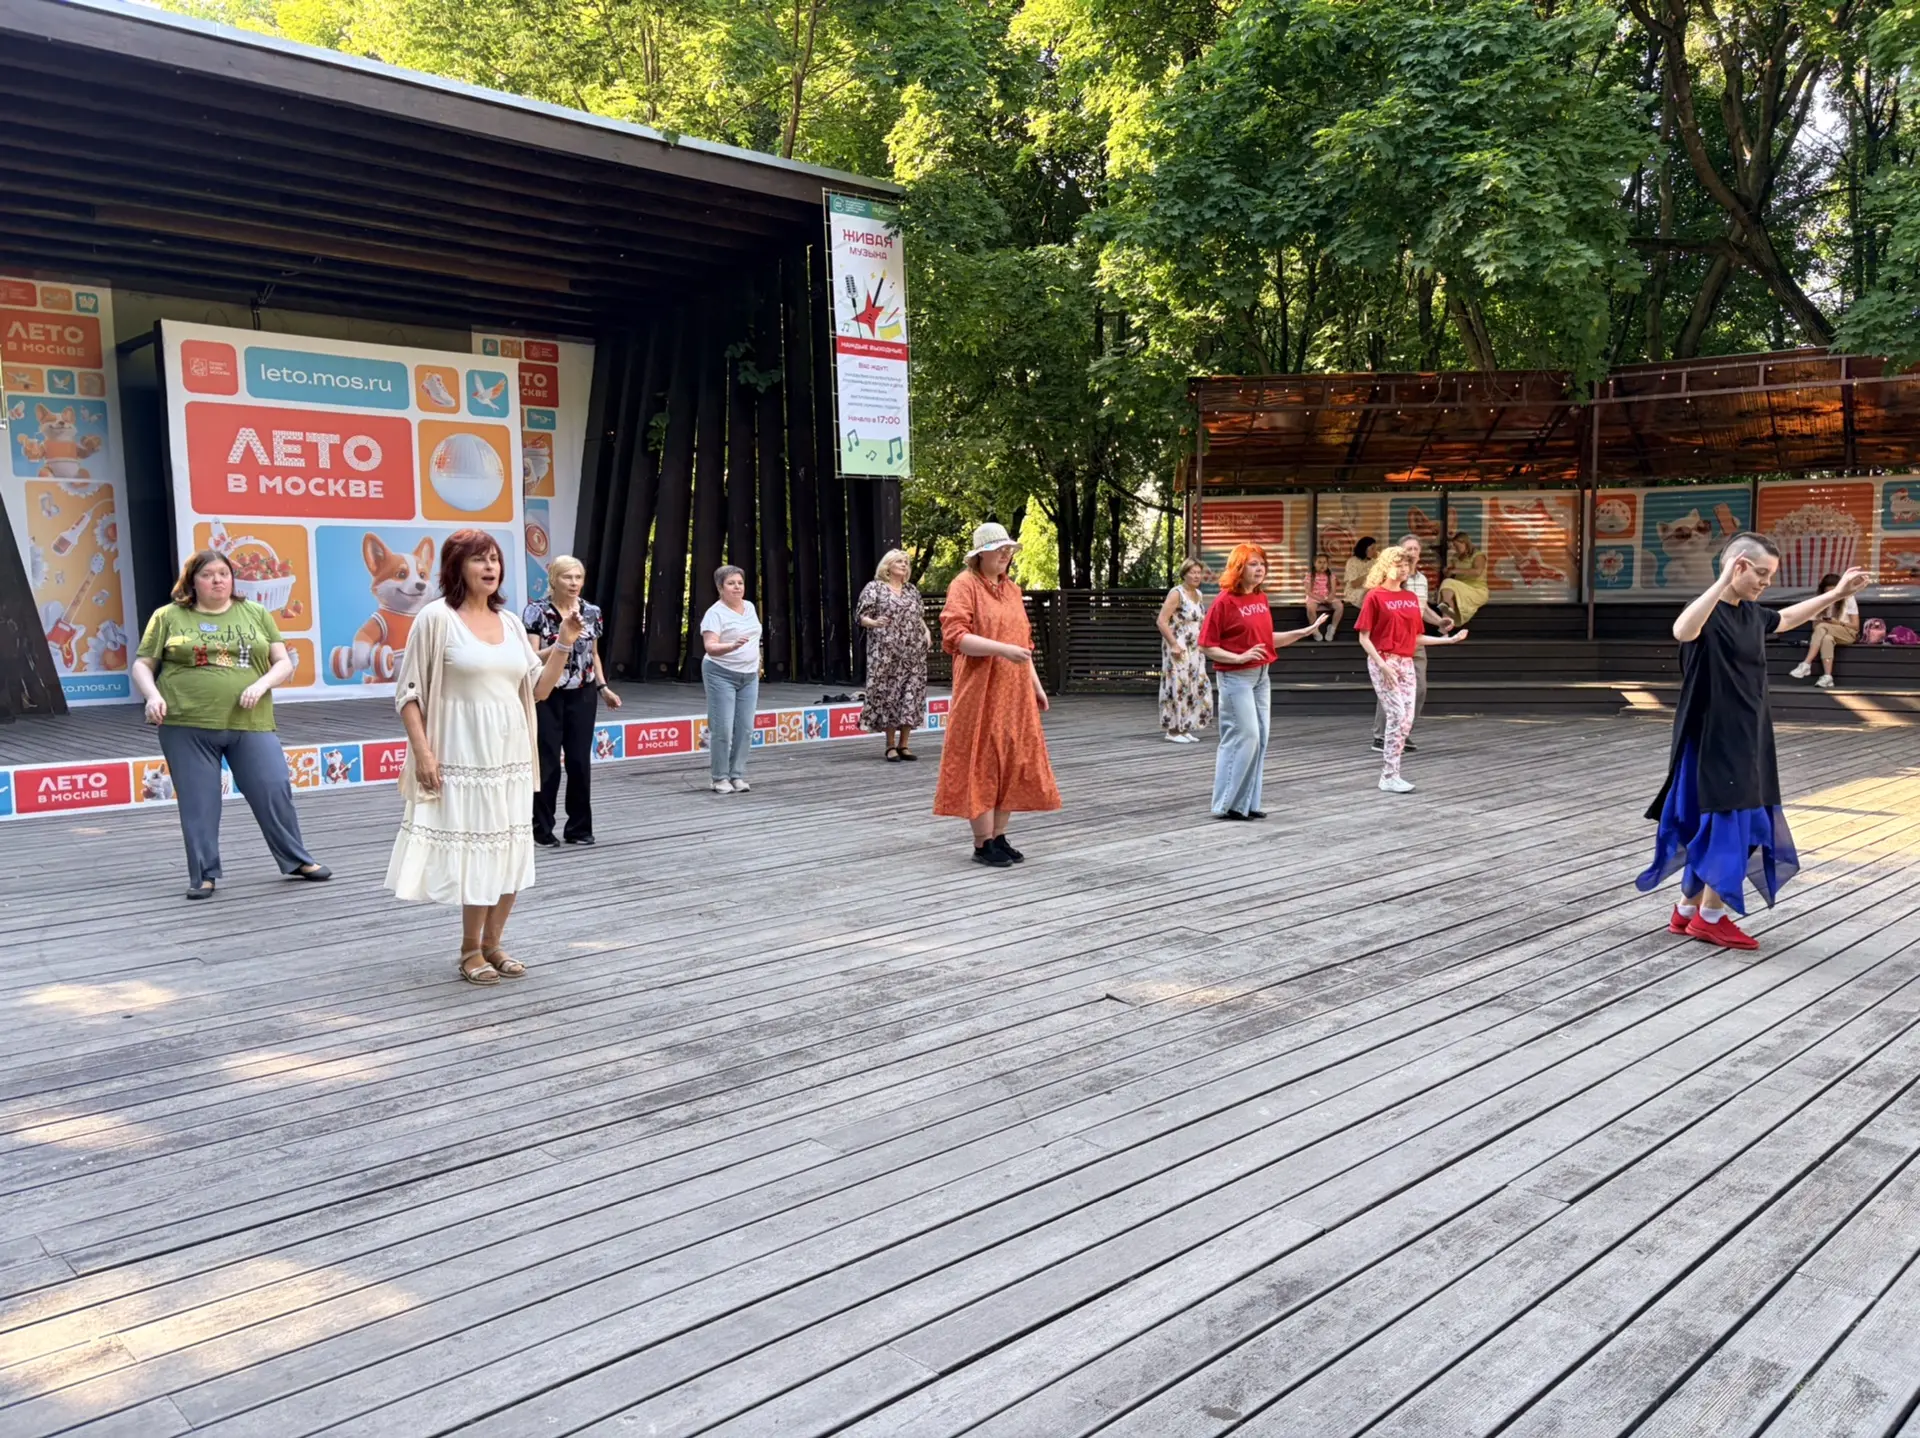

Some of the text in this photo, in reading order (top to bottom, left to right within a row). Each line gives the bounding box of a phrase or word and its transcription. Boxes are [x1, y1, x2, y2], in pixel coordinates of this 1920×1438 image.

[842, 229, 893, 249] ЖИВАЯ
[7, 320, 84, 344] ЛЕТО
[7, 341, 85, 357] В МОСКВЕ
[260, 363, 392, 392] leto.mos.ru
[520, 371, 547, 387] ТО
[522, 388, 548, 398] СКВЕ
[877, 416, 901, 425] 17:00
[226, 427, 383, 472] ЛЕТО
[226, 473, 385, 498] В МОСКВЕ
[62, 683, 121, 693] to.mos.ru
[840, 712, 860, 724] ЛЕТ
[638, 727, 679, 741] ЛЕТО
[645, 740, 679, 748] МОСКВЕ
[380, 749, 405, 764] ЛЕ
[38, 772, 107, 792] ЛЕТО
[37, 789, 108, 804] В МОСКВЕ
